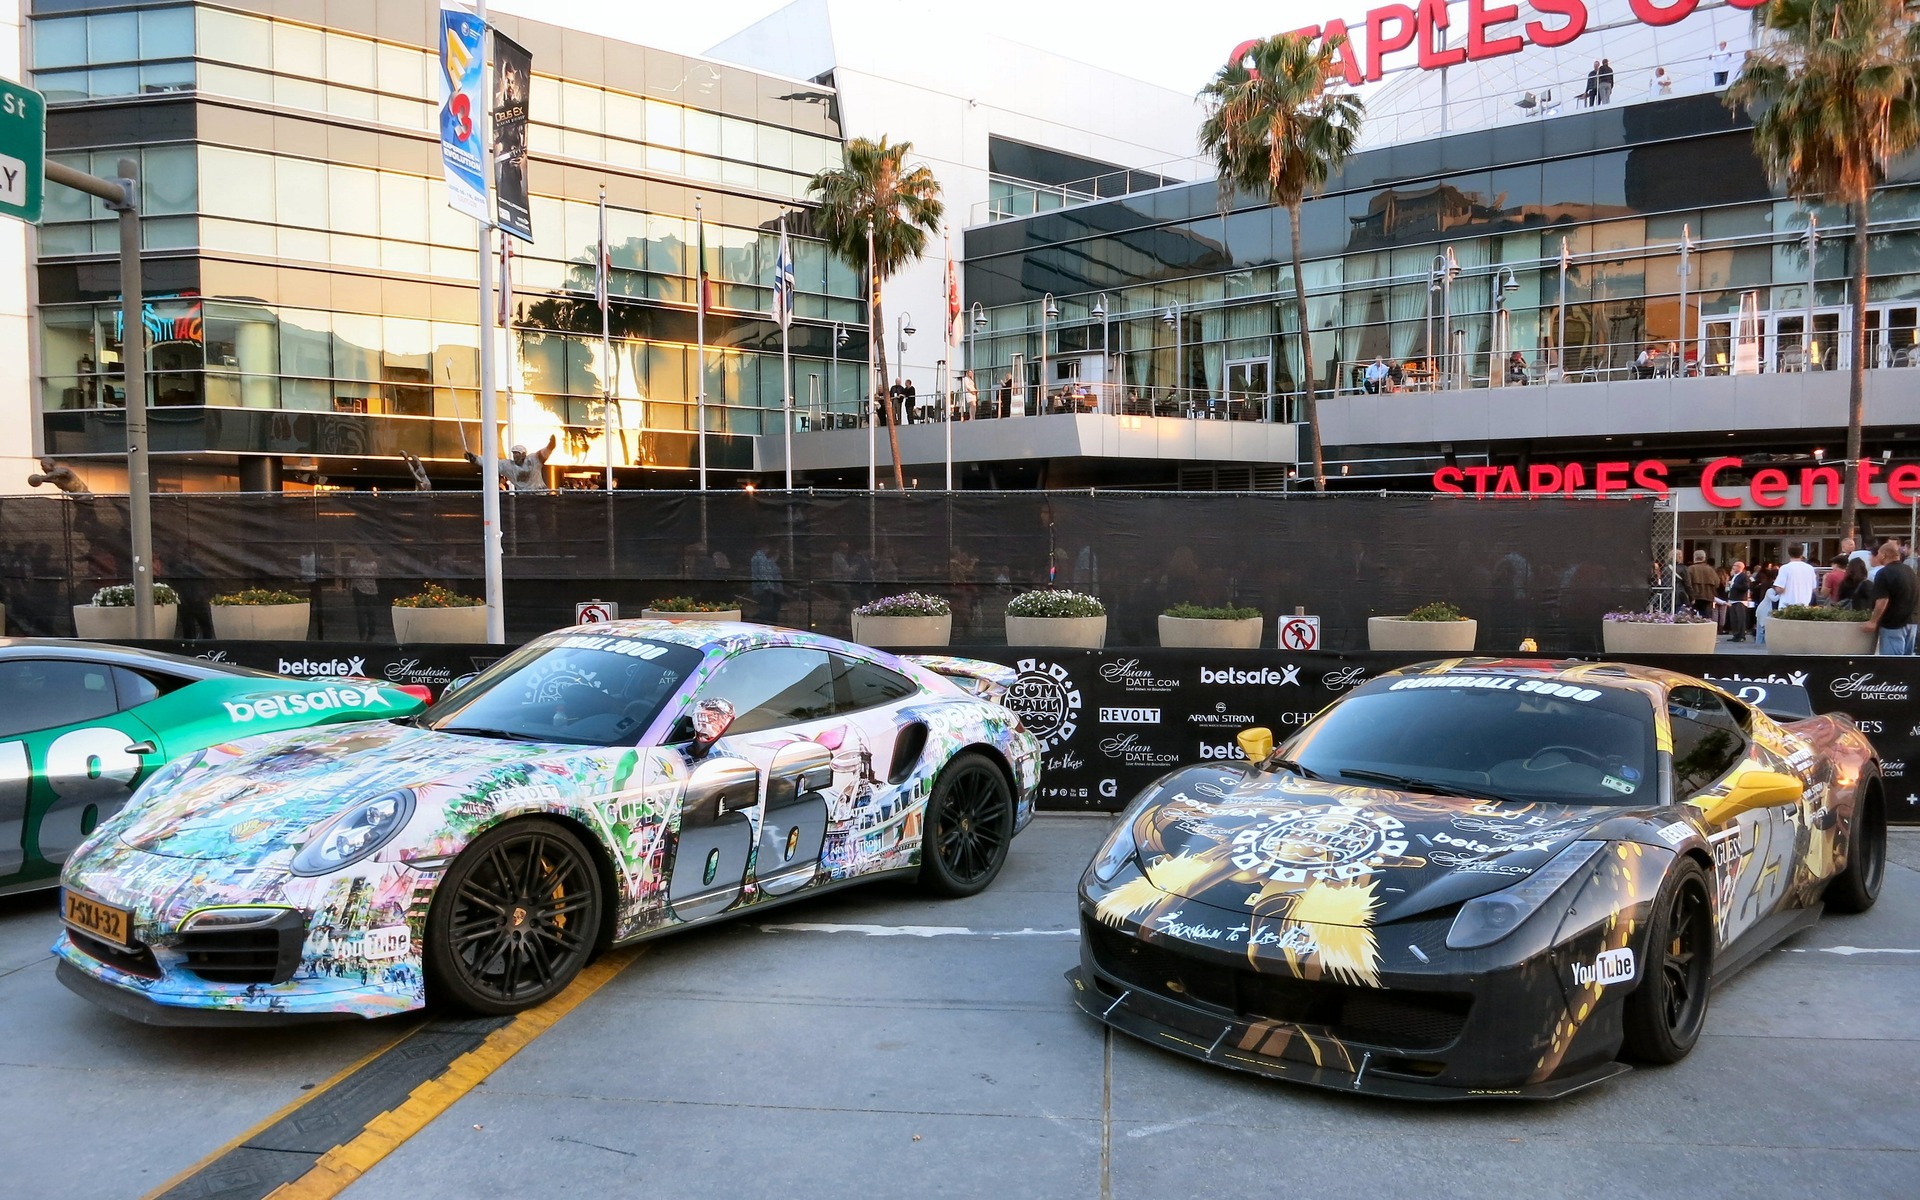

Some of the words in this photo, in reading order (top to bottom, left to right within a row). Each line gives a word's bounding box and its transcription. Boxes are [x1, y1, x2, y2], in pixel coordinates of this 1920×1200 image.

[3, 93, 26, 118] St
[443, 148, 481, 171] EVOLUTION
[1731, 517, 1765, 526] PLAZA
[604, 640, 669, 660] 3000
[278, 657, 350, 677] betsafe
[384, 658, 450, 682] Anastasia
[1100, 658, 1151, 683] Asian
[1200, 666, 1283, 685] betsafe
[1126, 678, 1180, 687] DATE.COM
[1389, 676, 1519, 691] GUMBALL
[1516, 680, 1602, 702] 3000
[1830, 673, 1909, 698] Anastasia
[222, 686, 359, 723] betsafe
[1861, 693, 1908, 701] DATE.COM
[1101, 710, 1159, 722] REVOLT
[1187, 715, 1220, 723] ARMIN
[1222, 715, 1255, 723] STROM
[1099, 733, 1151, 758] Asian
[1200, 742, 1247, 760] bets
[1125, 753, 1179, 762] DATE.COM
[492, 785, 555, 804] REVOLT
[1171, 792, 1247, 816] betsafe
[603, 793, 666, 825] GUESS
[669, 741, 833, 922] 66
[1432, 833, 1530, 853] betsafe
[1716, 836, 1741, 867] GUESS
[1457, 865, 1533, 874] DATE.COM
[69, 896, 120, 938] 7-SXJ-32
[331, 934, 407, 959] YouTube
[1571, 954, 1633, 986] YouTube
